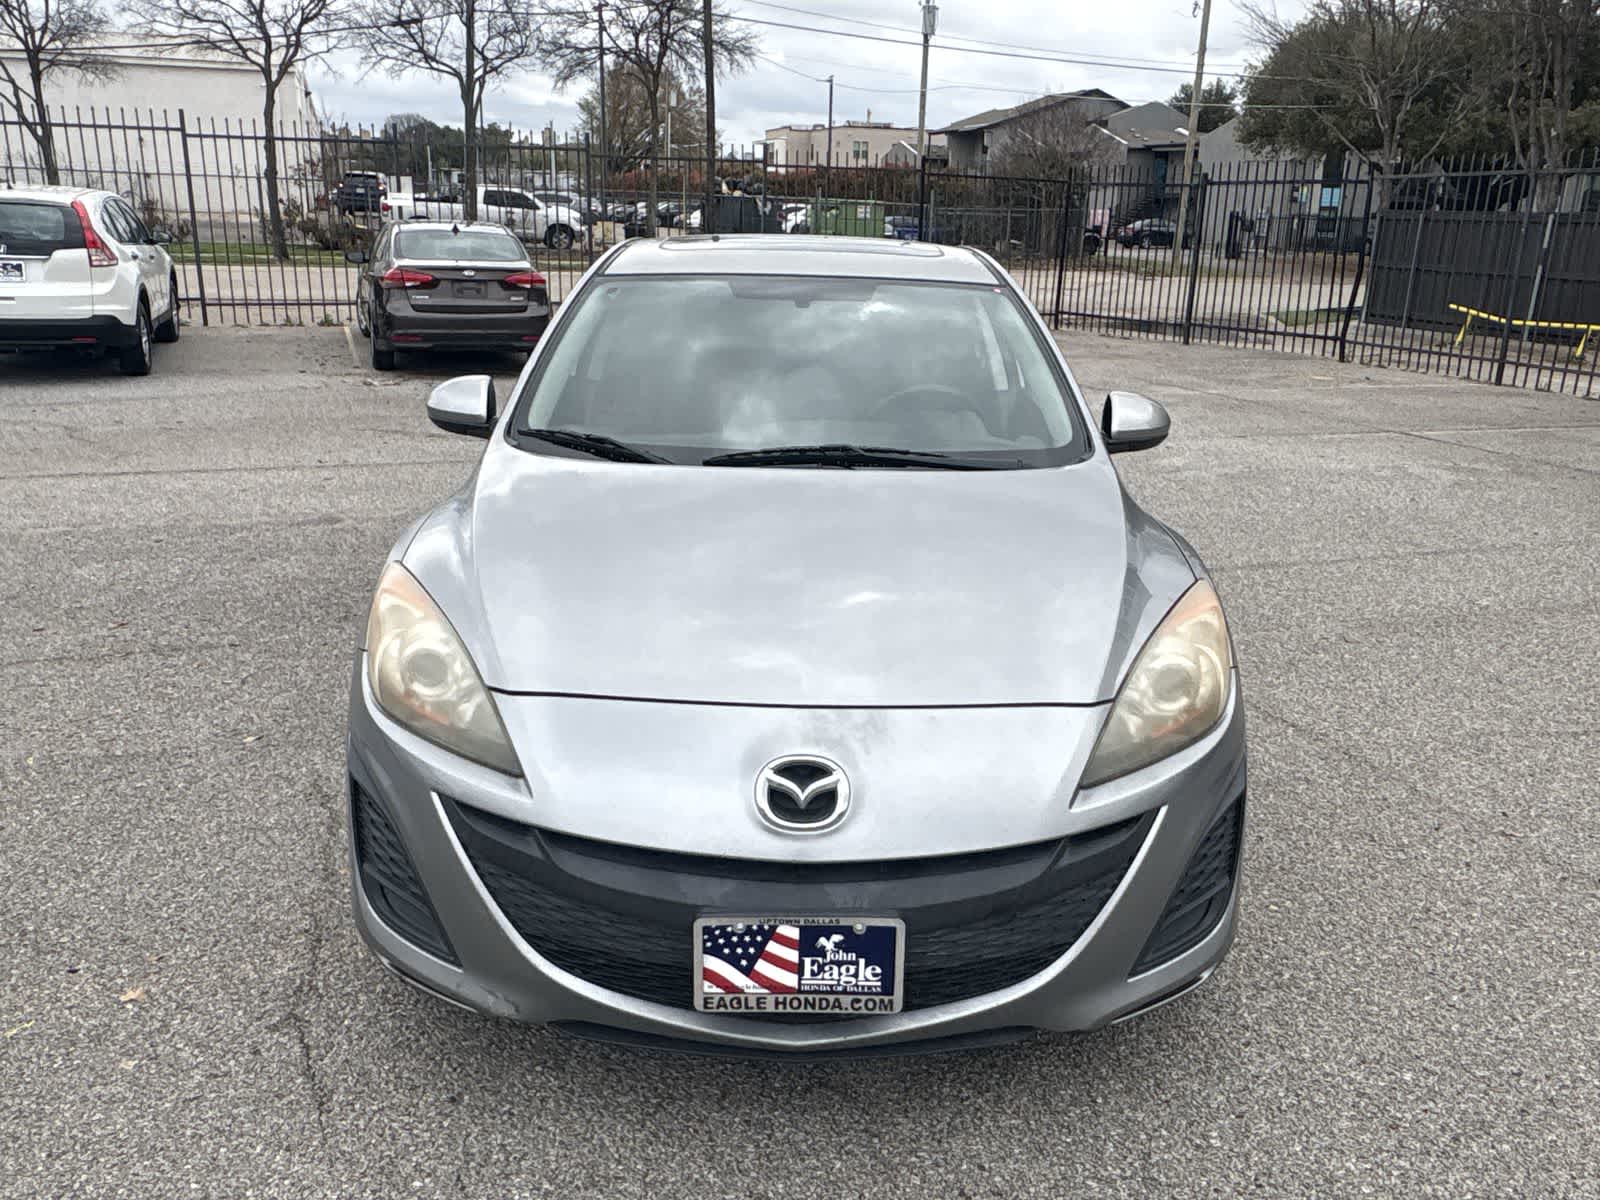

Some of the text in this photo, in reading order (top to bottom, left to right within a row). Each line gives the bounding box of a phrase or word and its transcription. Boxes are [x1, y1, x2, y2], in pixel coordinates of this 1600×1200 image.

[824, 949, 857, 963] John
[801, 957, 882, 986] Eagle
[801, 984, 831, 992] HONDA
[846, 985, 882, 993] DALLAS
[703, 996, 894, 1012] EAGLE HONDA.COM
